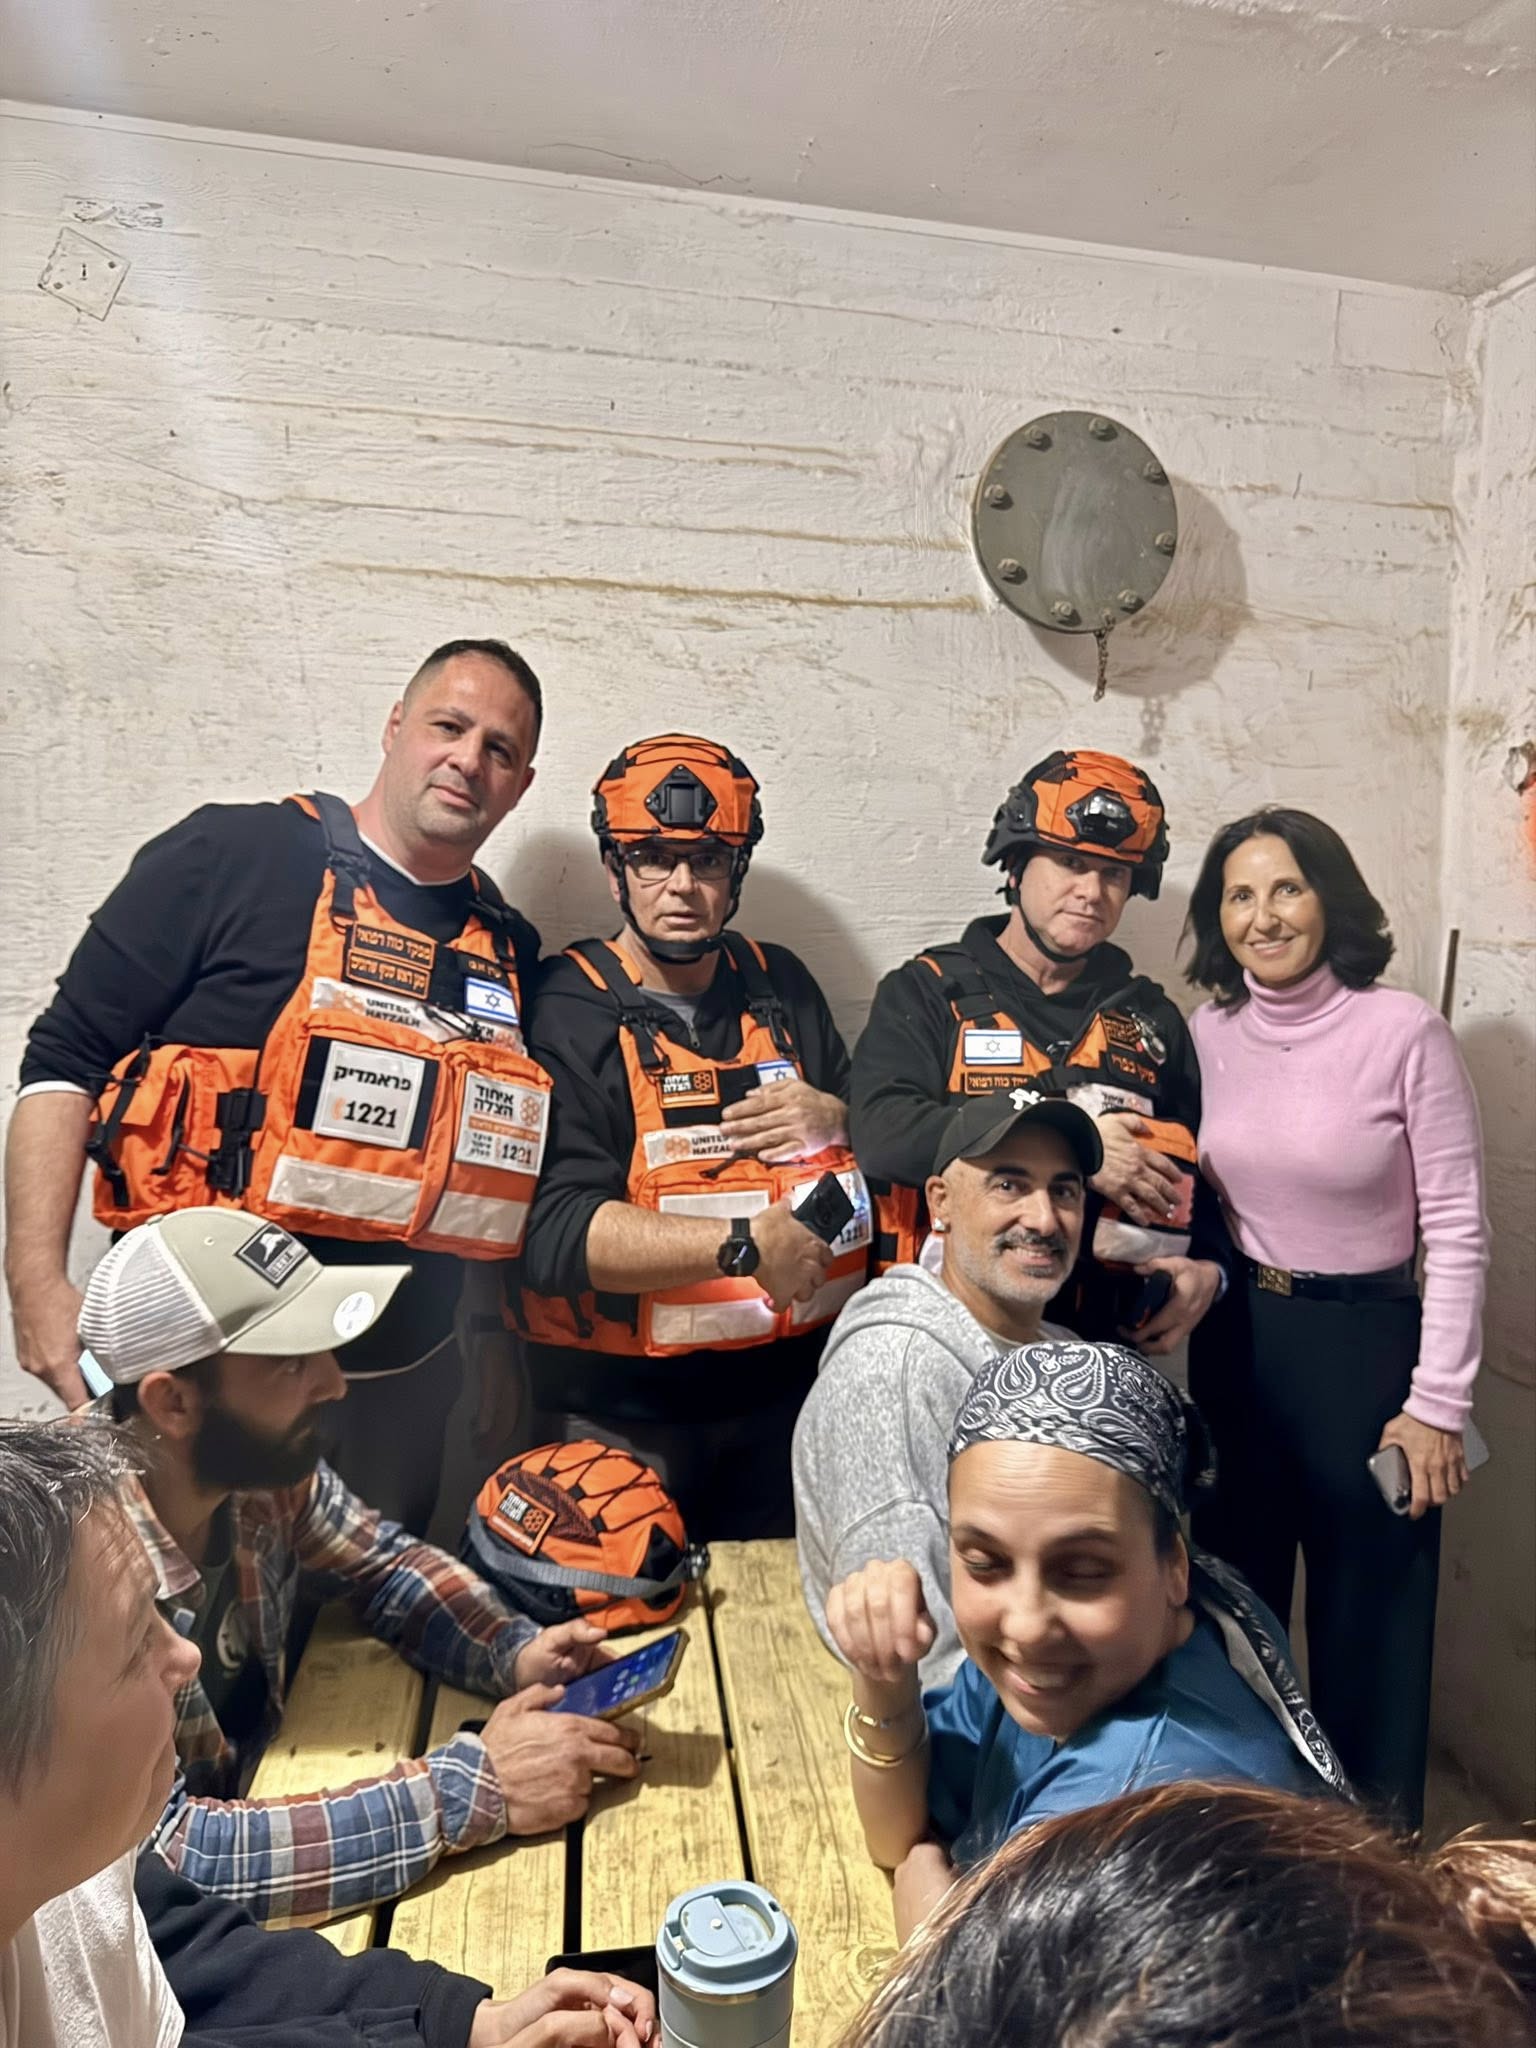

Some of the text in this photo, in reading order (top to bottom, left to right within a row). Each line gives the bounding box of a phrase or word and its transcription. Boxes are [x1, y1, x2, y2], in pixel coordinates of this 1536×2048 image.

[334, 1066, 412, 1091] פראמדיק
[475, 1084, 514, 1105] איחוד
[344, 1100, 397, 1129] 1221
[473, 1097, 513, 1118] הצלה
[502, 1143, 532, 1164] 1221
[692, 1144, 731, 1156] HATZAL
